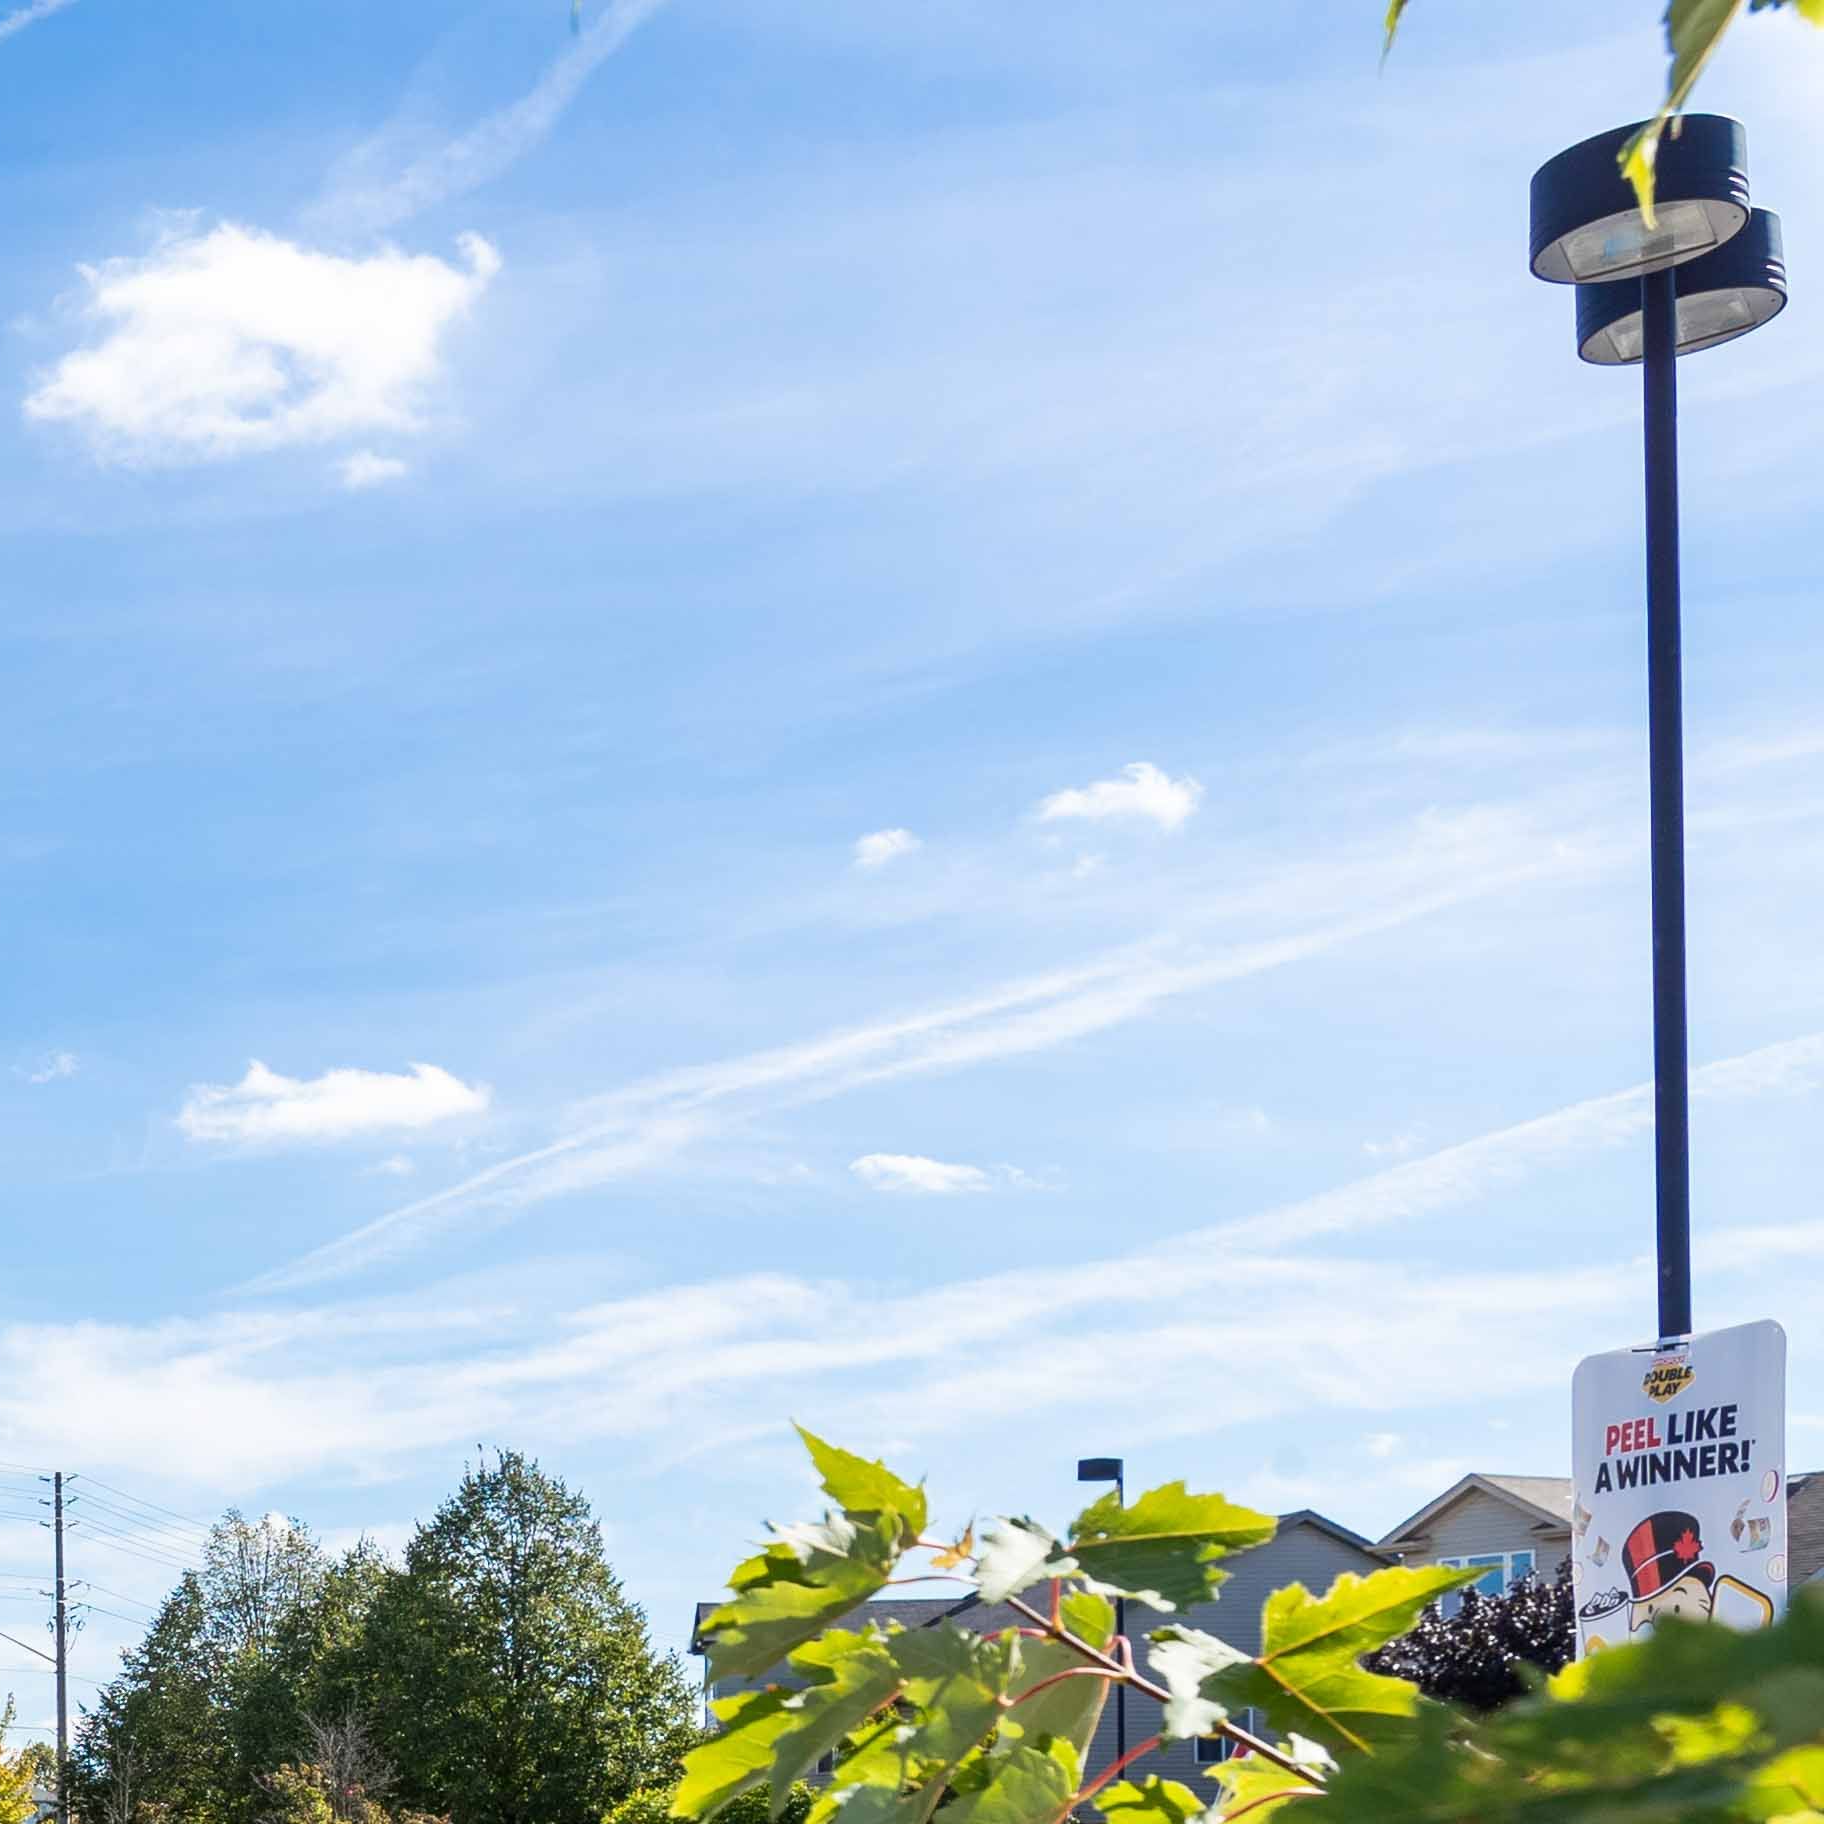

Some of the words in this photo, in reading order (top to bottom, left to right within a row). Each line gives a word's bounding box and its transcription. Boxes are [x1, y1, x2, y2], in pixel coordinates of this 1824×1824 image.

[1643, 1366, 1693, 1386] DOUBLE
[1648, 1382, 1682, 1399] PLAY
[1605, 1417, 1662, 1457] PEEL
[1667, 1404, 1738, 1446] LIKE
[1594, 1462, 1613, 1494] A
